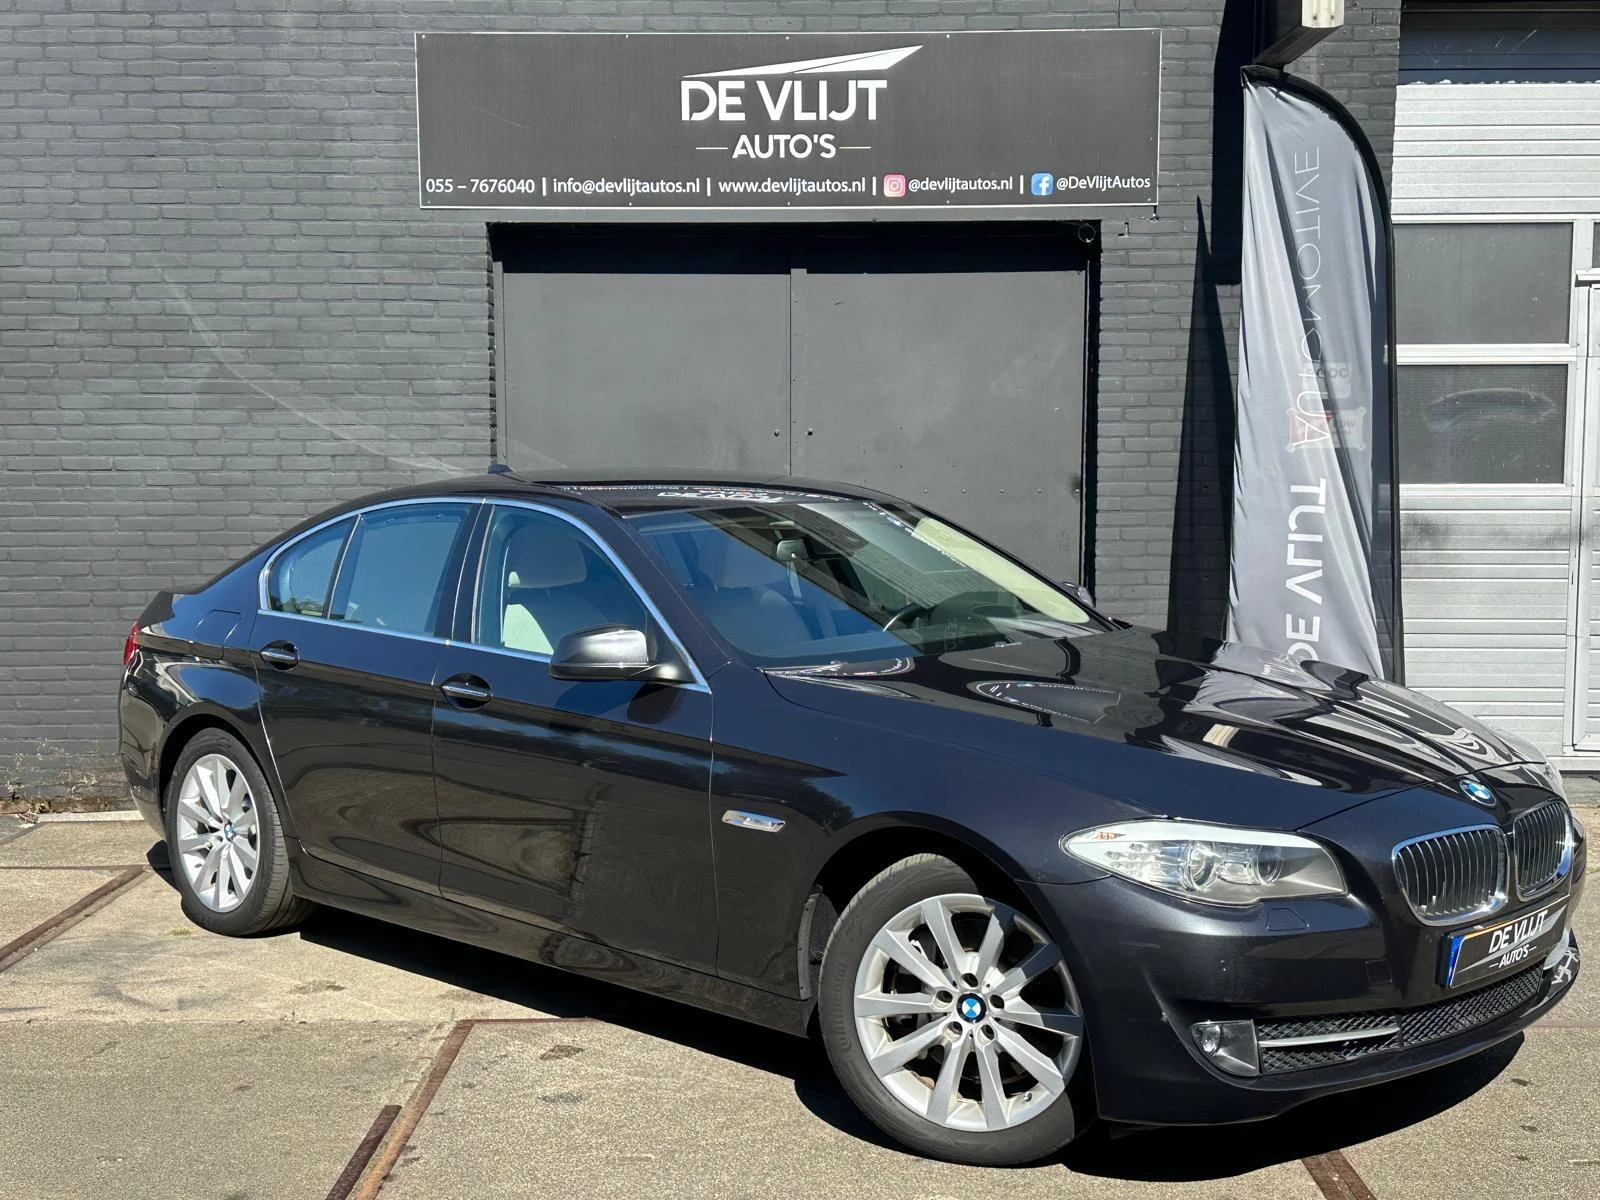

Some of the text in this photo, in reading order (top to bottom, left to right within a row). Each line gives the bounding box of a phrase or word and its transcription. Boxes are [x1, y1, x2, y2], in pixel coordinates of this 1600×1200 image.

[681, 79, 888, 121] DE VLIJT
[732, 133, 837, 159] AUTO'S
[425, 178, 454, 193] 055
[469, 178, 536, 194] 7676040
[552, 177, 700, 197] info@devlijtautos.nl
[718, 176, 866, 197] www.devlijtautos.nl
[908, 176, 1013, 194] @devlijtautos.nl
[1056, 175, 1151, 192] @DeVlijtAutos
[1489, 911, 1548, 953] DE VLIJT
[1498, 944, 1530, 968] AUTO'S
